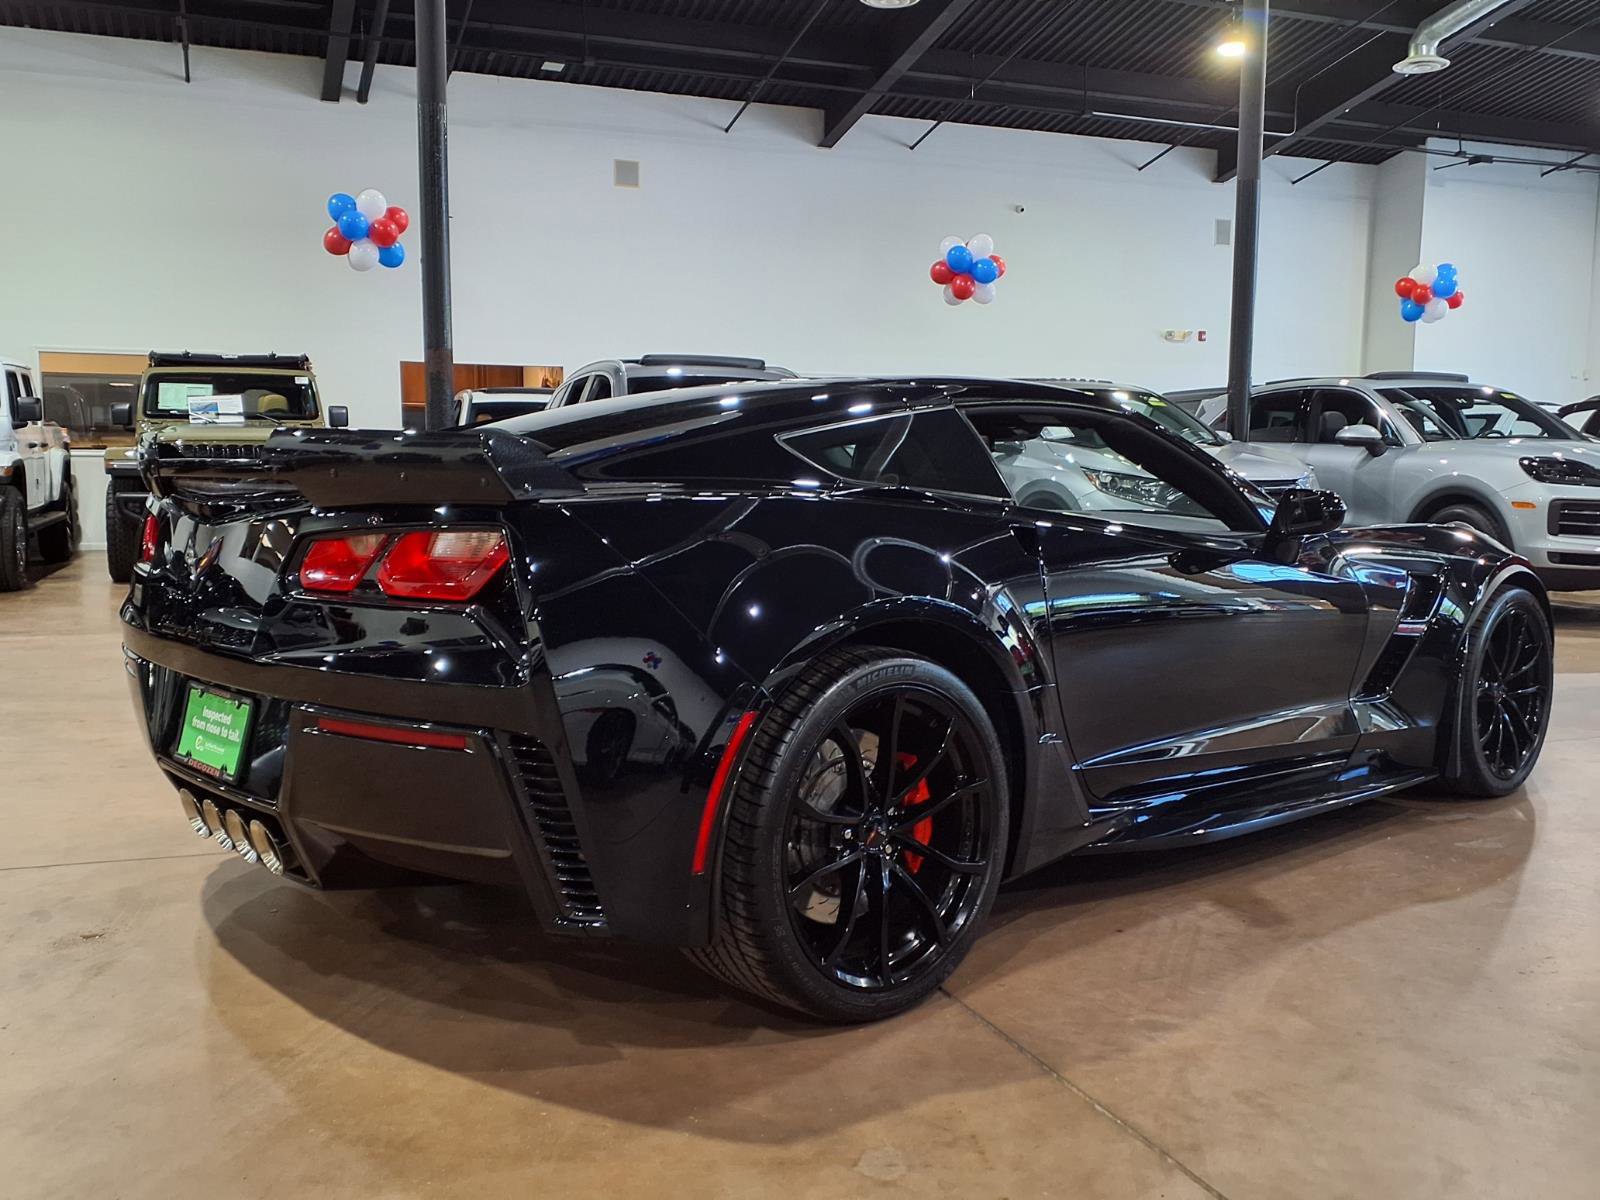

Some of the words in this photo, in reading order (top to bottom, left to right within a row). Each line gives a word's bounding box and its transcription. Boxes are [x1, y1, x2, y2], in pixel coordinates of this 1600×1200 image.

[857, 664, 914, 689] MICHELIN
[203, 706, 232, 725] Inspected
[192, 716, 206, 730] from
[206, 722, 220, 735] nose
[220, 726, 228, 738] to
